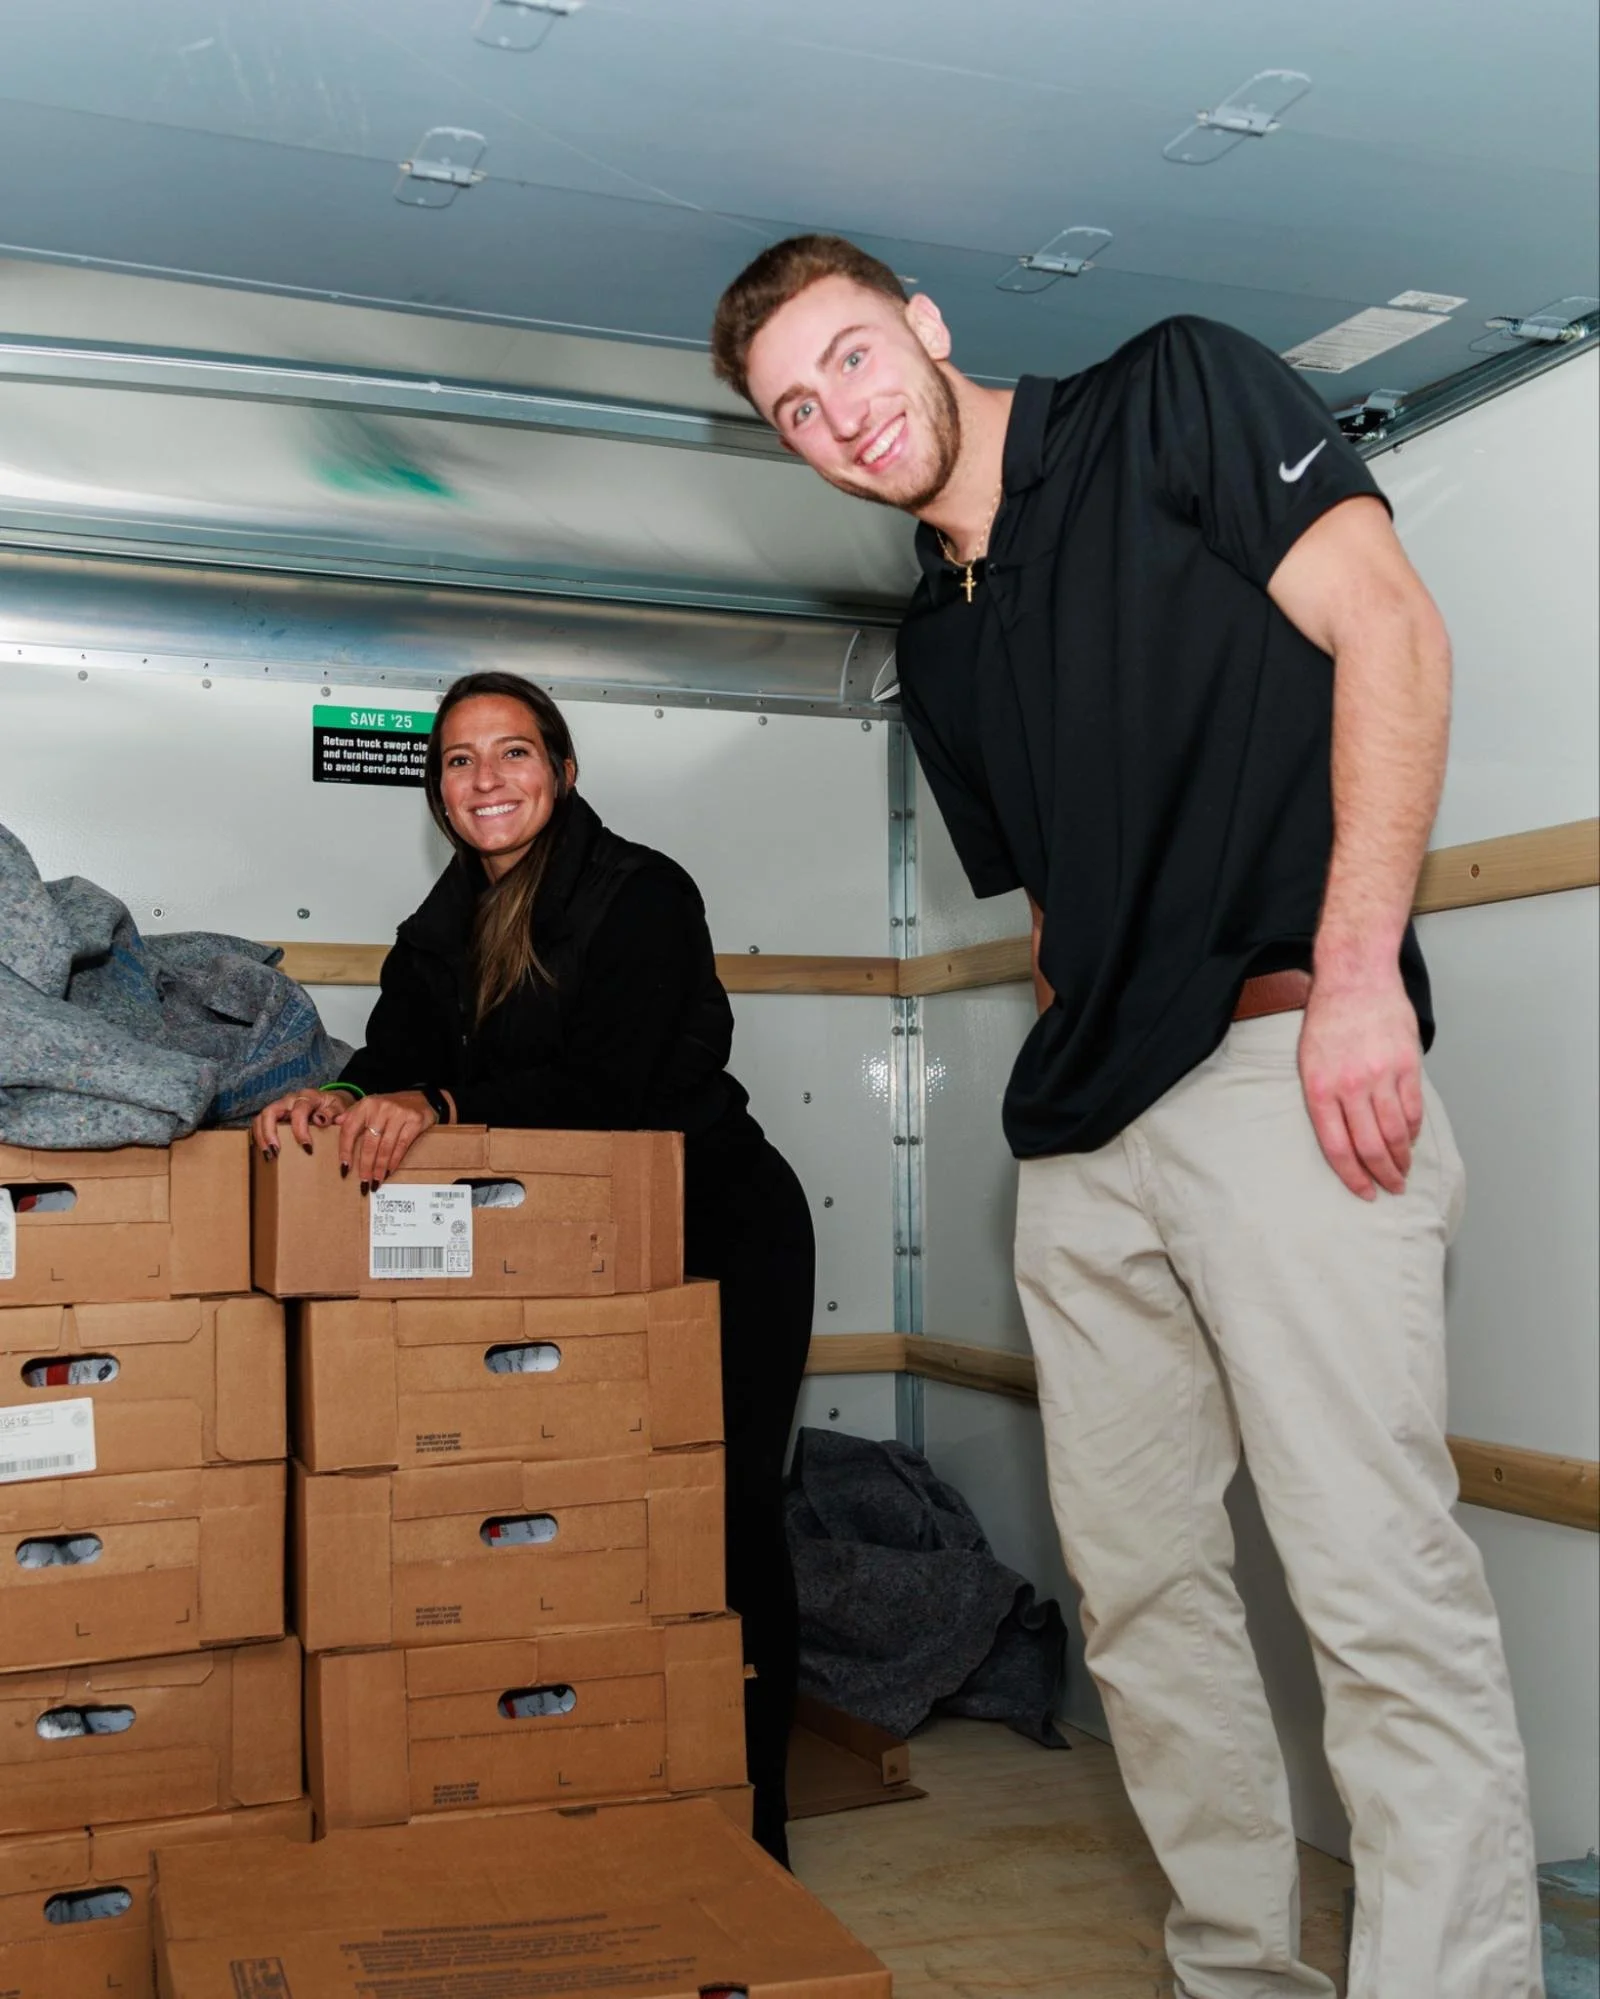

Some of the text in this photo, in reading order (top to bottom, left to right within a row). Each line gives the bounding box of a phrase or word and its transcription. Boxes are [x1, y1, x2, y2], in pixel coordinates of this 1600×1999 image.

[350, 711, 385, 727] SAVE
[323, 735, 428, 752] Return truck swept cle
[323, 749, 427, 764] and furniture pads fol
[323, 761, 426, 778] to avoid service charg
